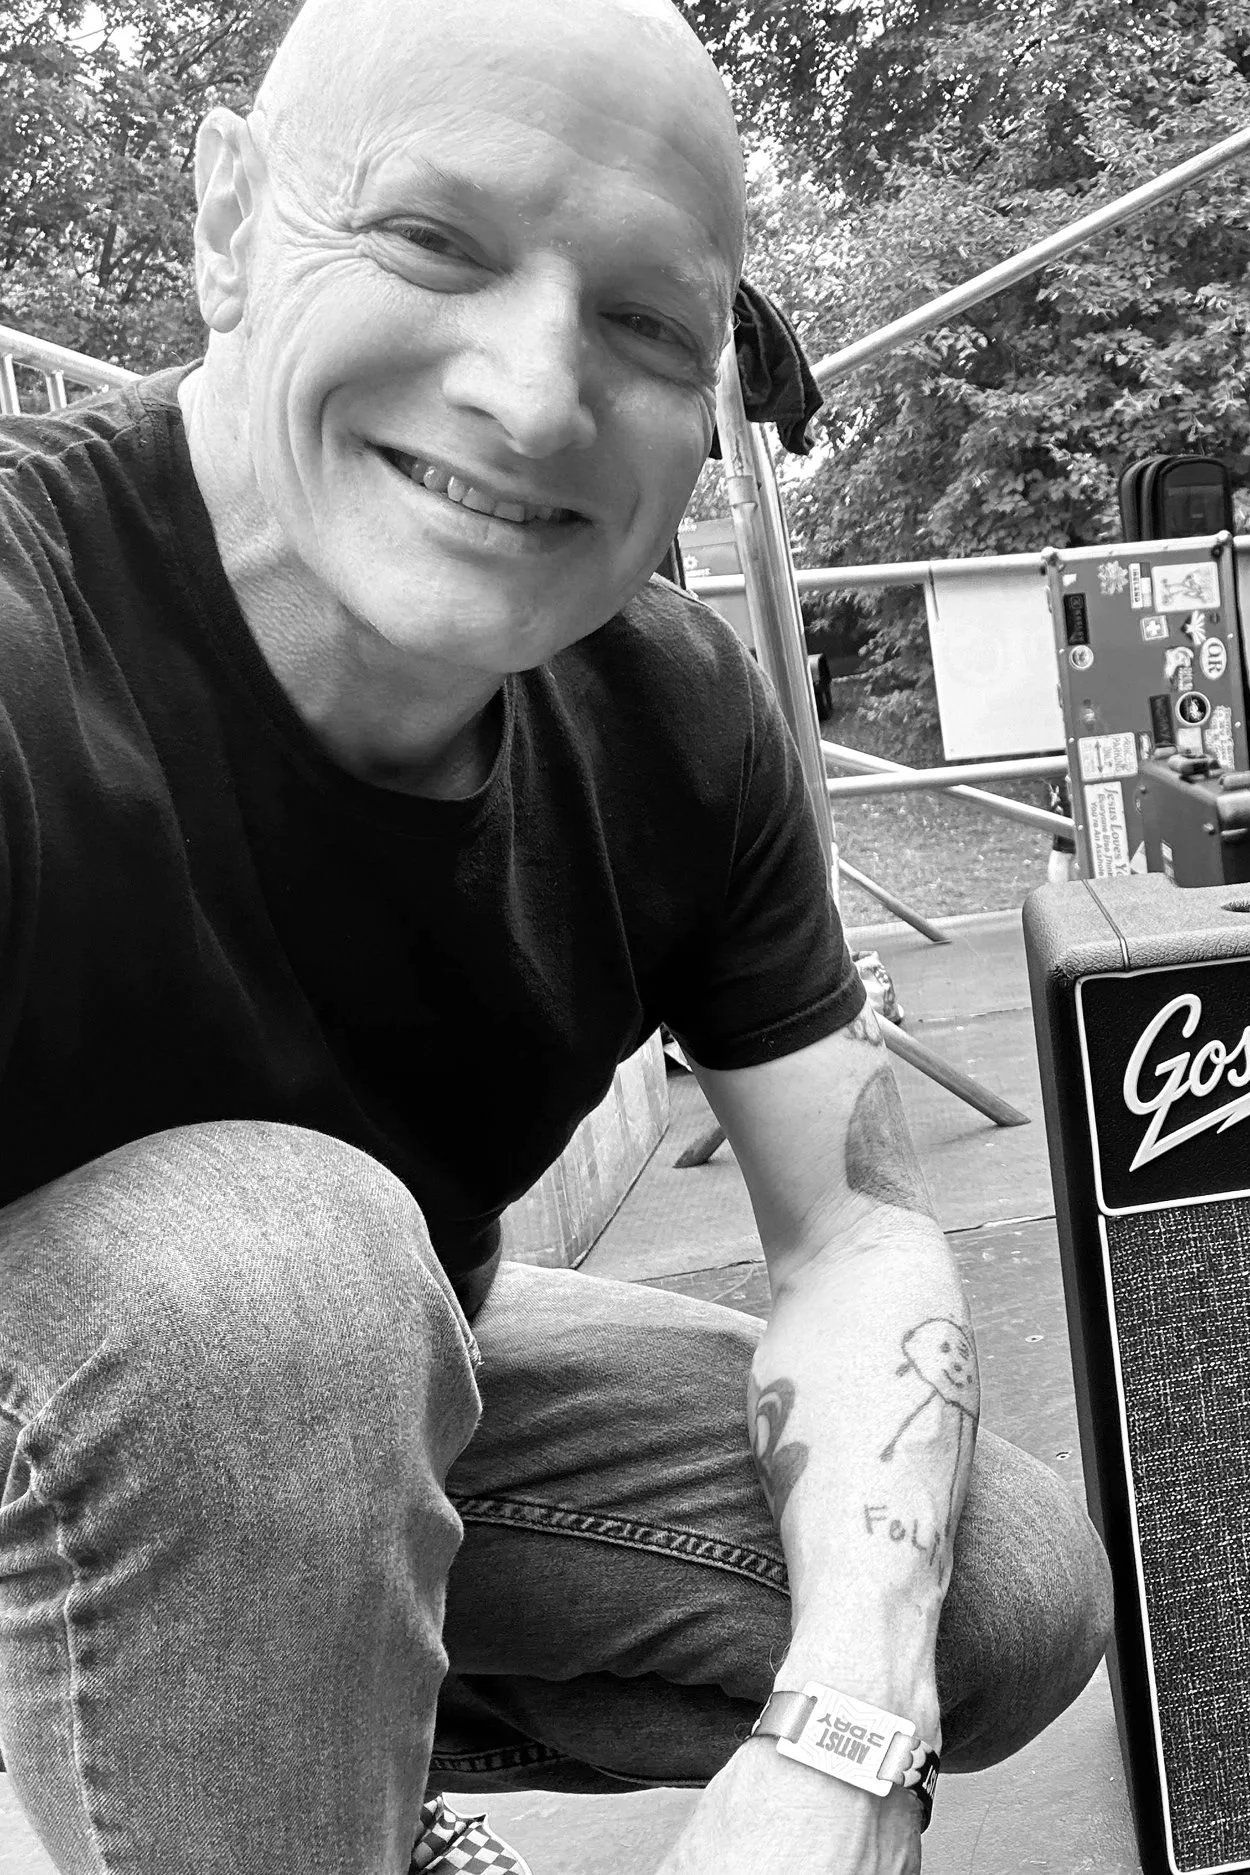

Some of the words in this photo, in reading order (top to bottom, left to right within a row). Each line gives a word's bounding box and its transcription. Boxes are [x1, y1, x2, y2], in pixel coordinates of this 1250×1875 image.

[1104, 788, 1119, 821] Jesus
[1110, 824, 1123, 860] Loves
[815, 1727, 871, 1765] ARTIST
